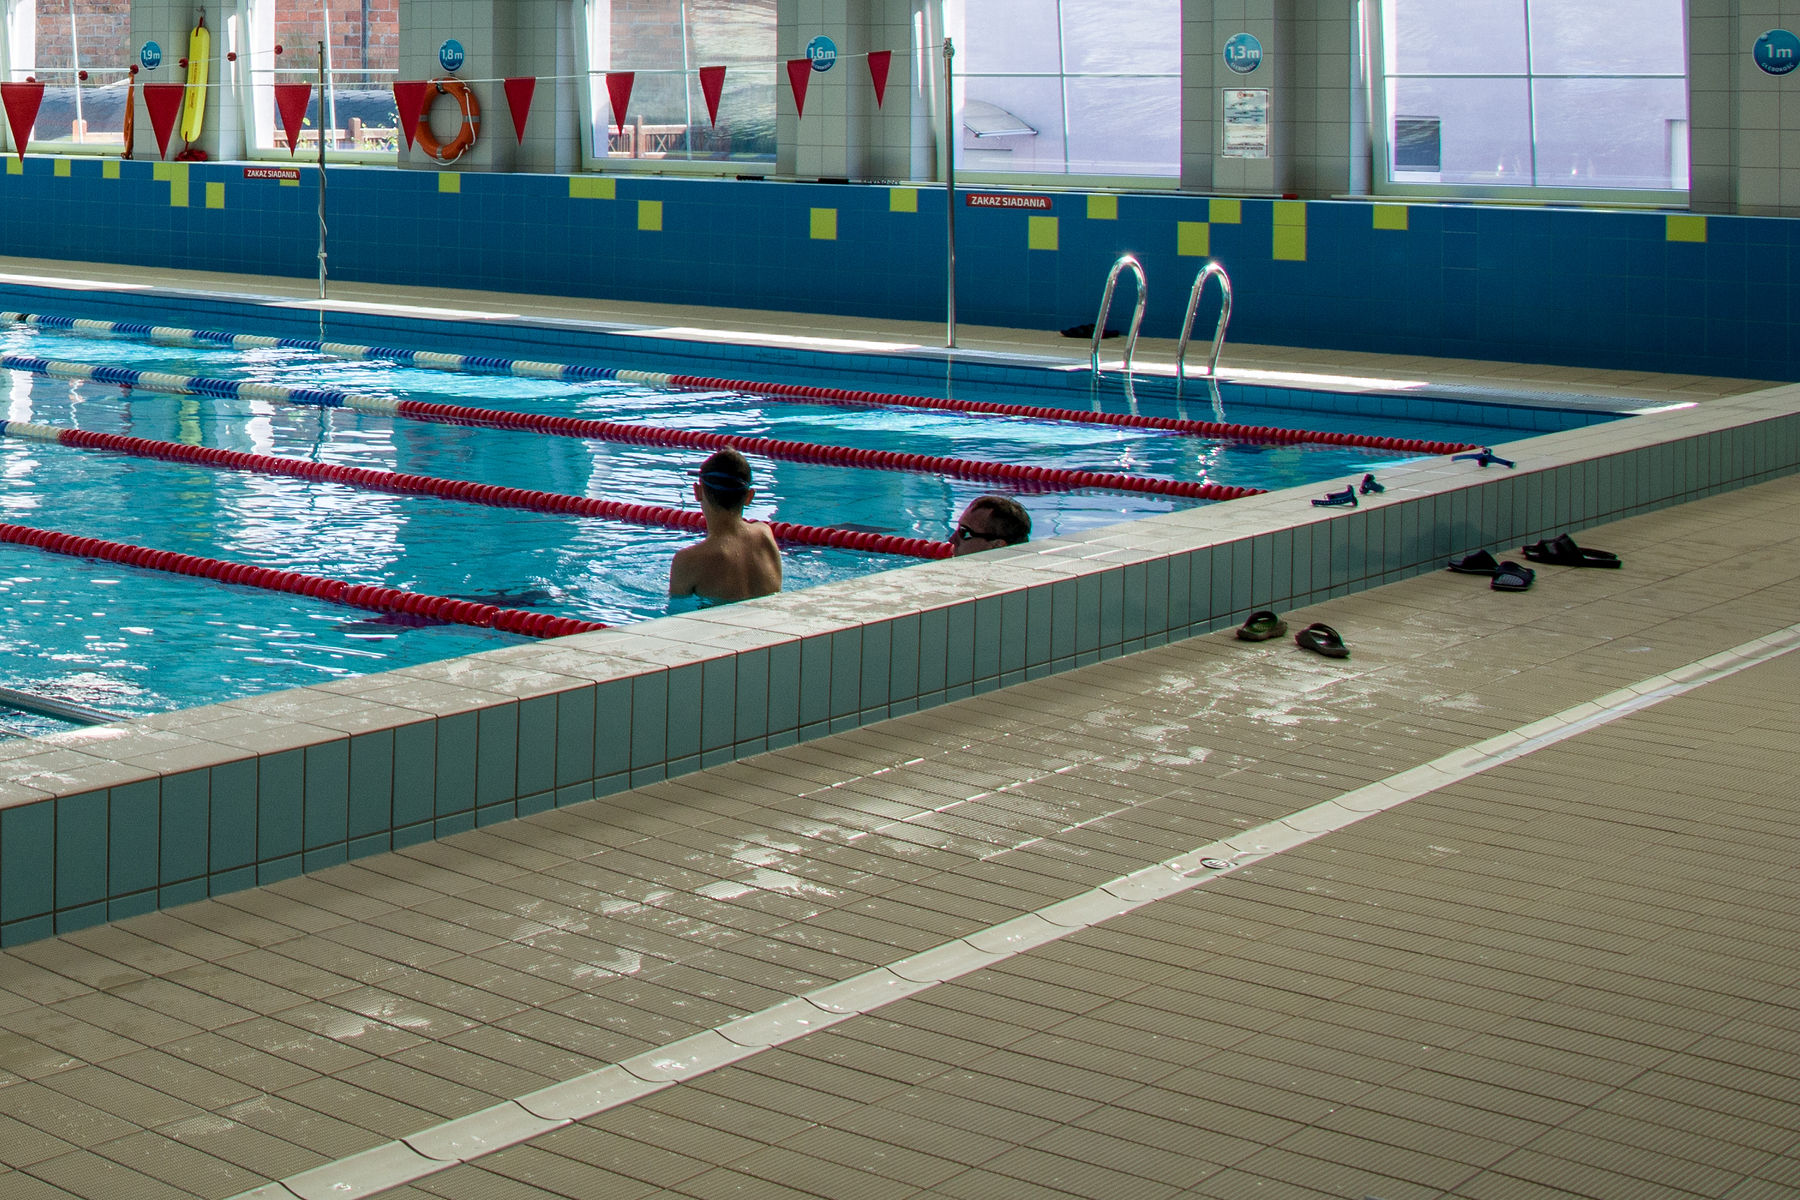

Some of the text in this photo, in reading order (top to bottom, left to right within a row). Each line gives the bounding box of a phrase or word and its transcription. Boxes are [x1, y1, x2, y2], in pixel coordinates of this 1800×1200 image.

[247, 169, 297, 178] ZAKAZ SIADANIA
[971, 196, 1046, 208] ZAKAZ SIADANIA
